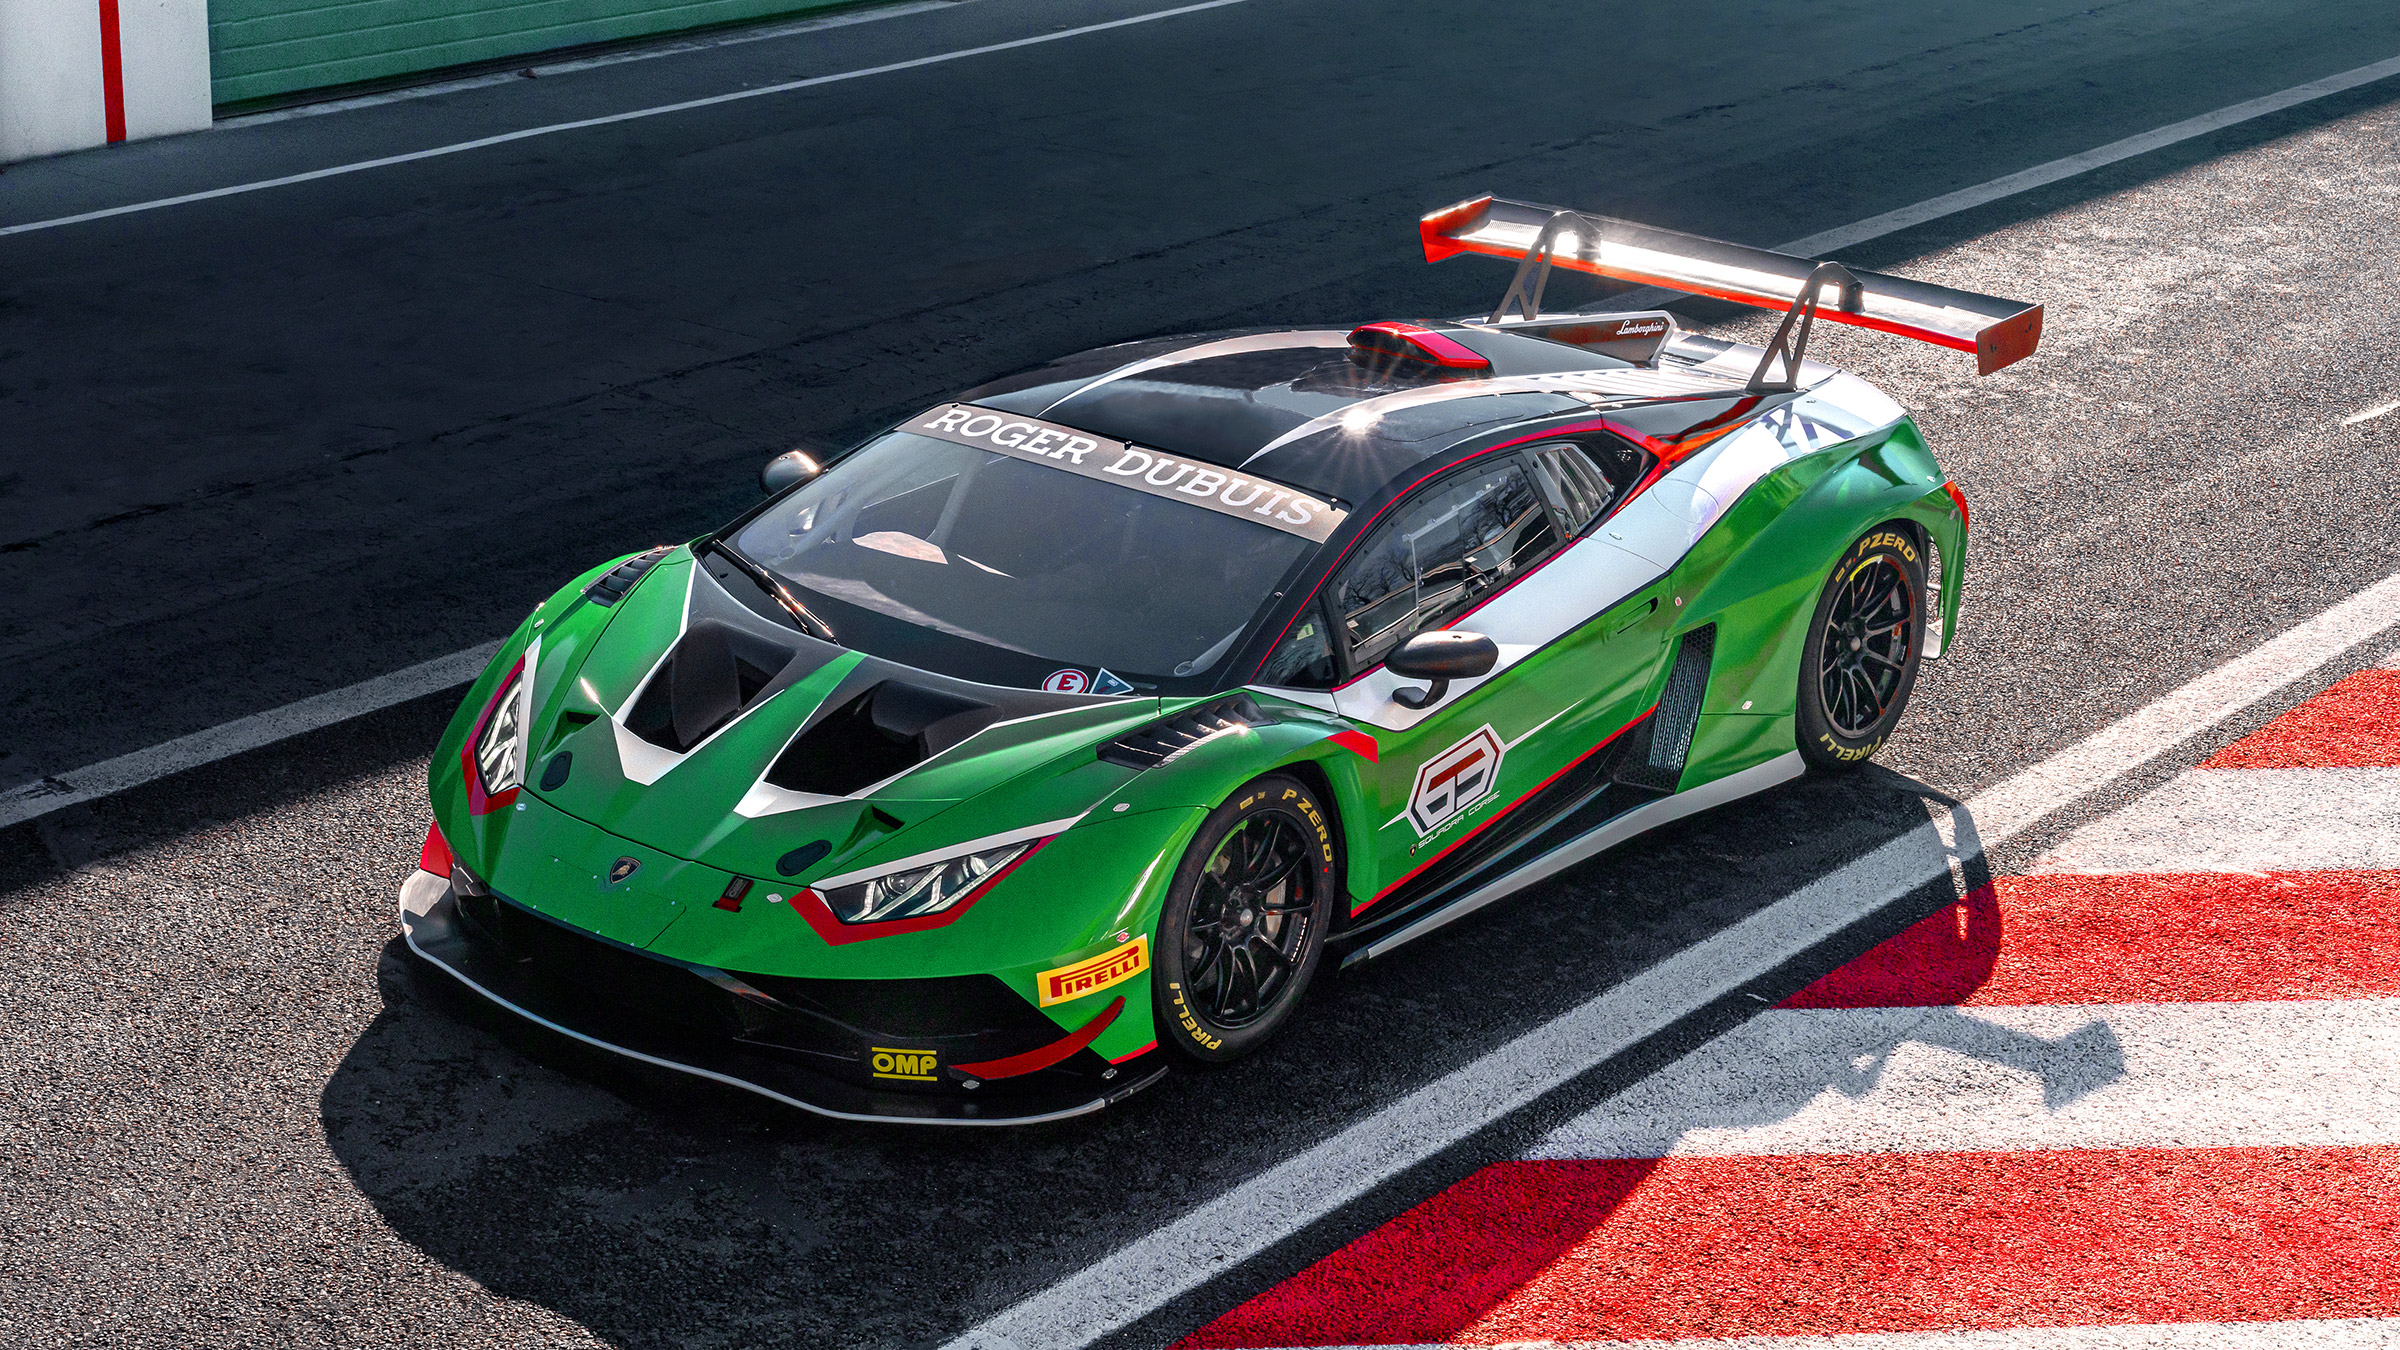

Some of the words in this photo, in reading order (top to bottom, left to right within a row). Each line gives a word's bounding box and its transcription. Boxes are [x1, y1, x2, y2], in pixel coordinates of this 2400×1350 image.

[1616, 319, 1664, 336] Lamborghini
[923, 408, 1098, 465] ROGER
[1103, 448, 1324, 525] DUBUIS
[1056, 674, 1078, 691] E
[1820, 732, 1882, 761] PIRELLI
[1418, 814, 1464, 849] SQUADRA
[1048, 945, 1140, 998] PIRELLI
[1169, 982, 1223, 1050] PIRELLI
[872, 1053, 937, 1075] OMP
